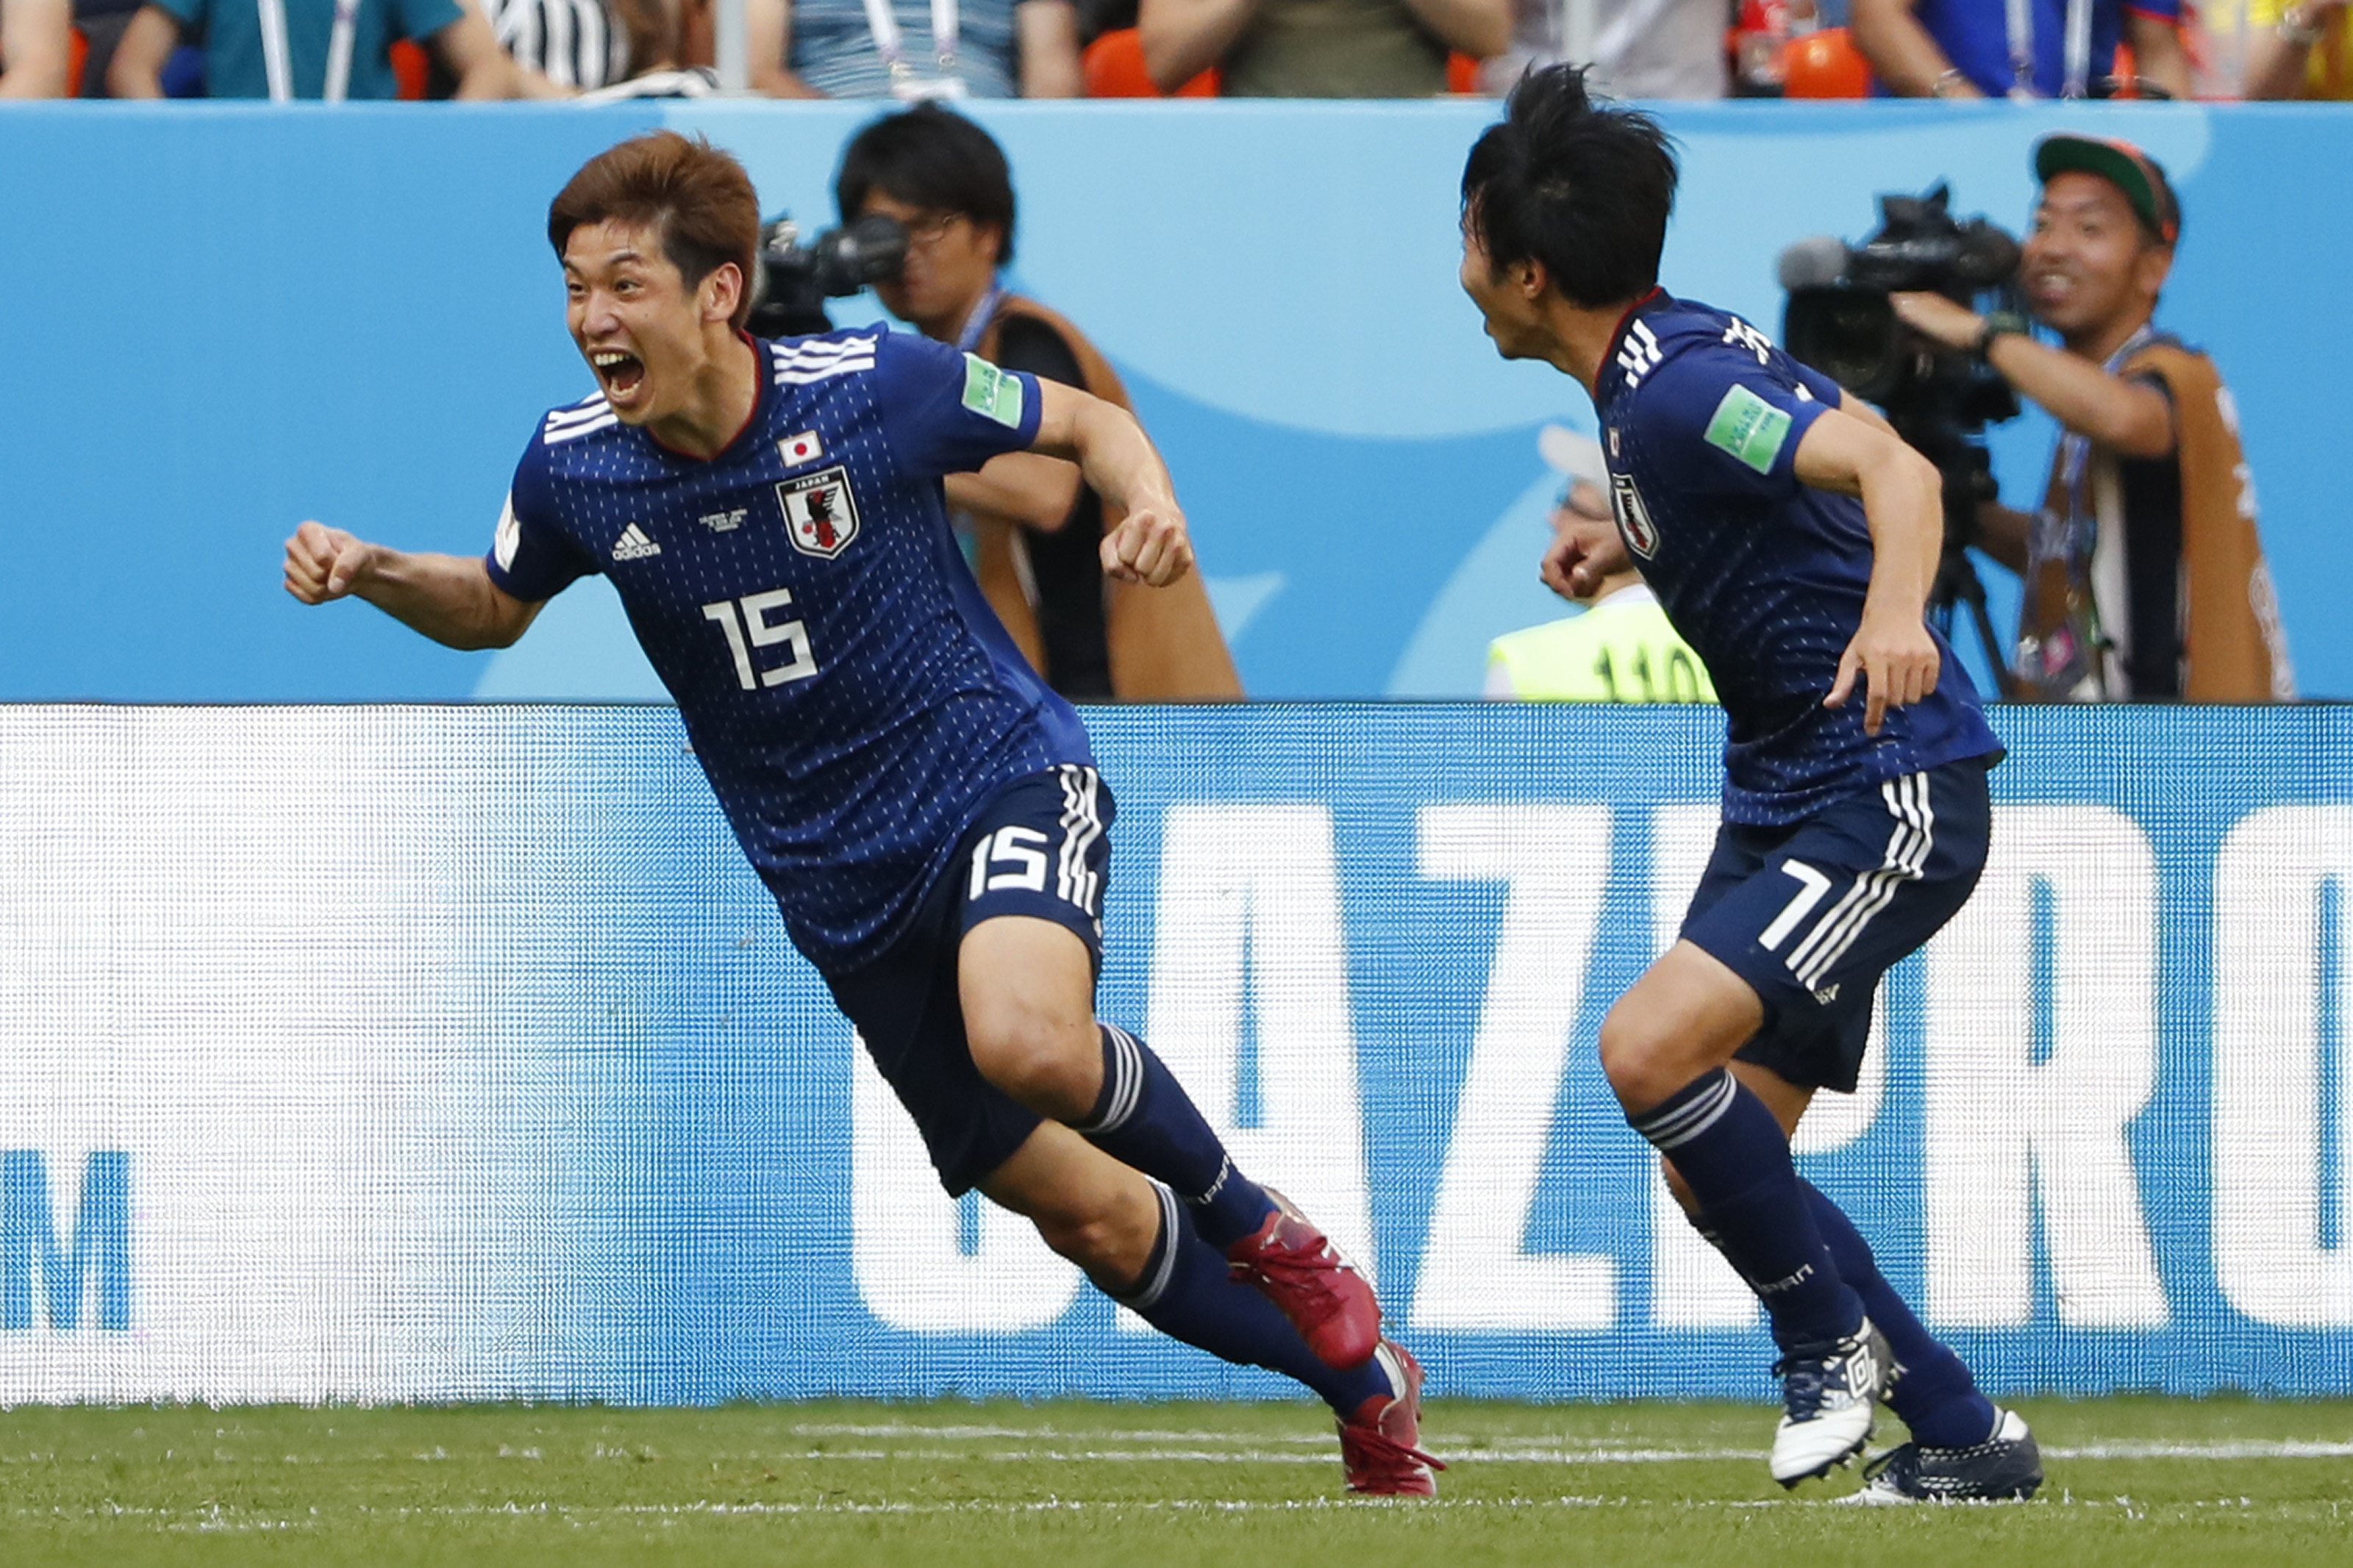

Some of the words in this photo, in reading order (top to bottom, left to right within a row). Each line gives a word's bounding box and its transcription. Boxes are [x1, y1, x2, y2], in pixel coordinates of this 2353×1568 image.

[795, 475, 829, 490] JAPAN
[612, 543, 661, 561] adidas
[701, 588, 818, 690] 15
[969, 826, 1048, 901] 15
[1758, 859, 1832, 951] 7
